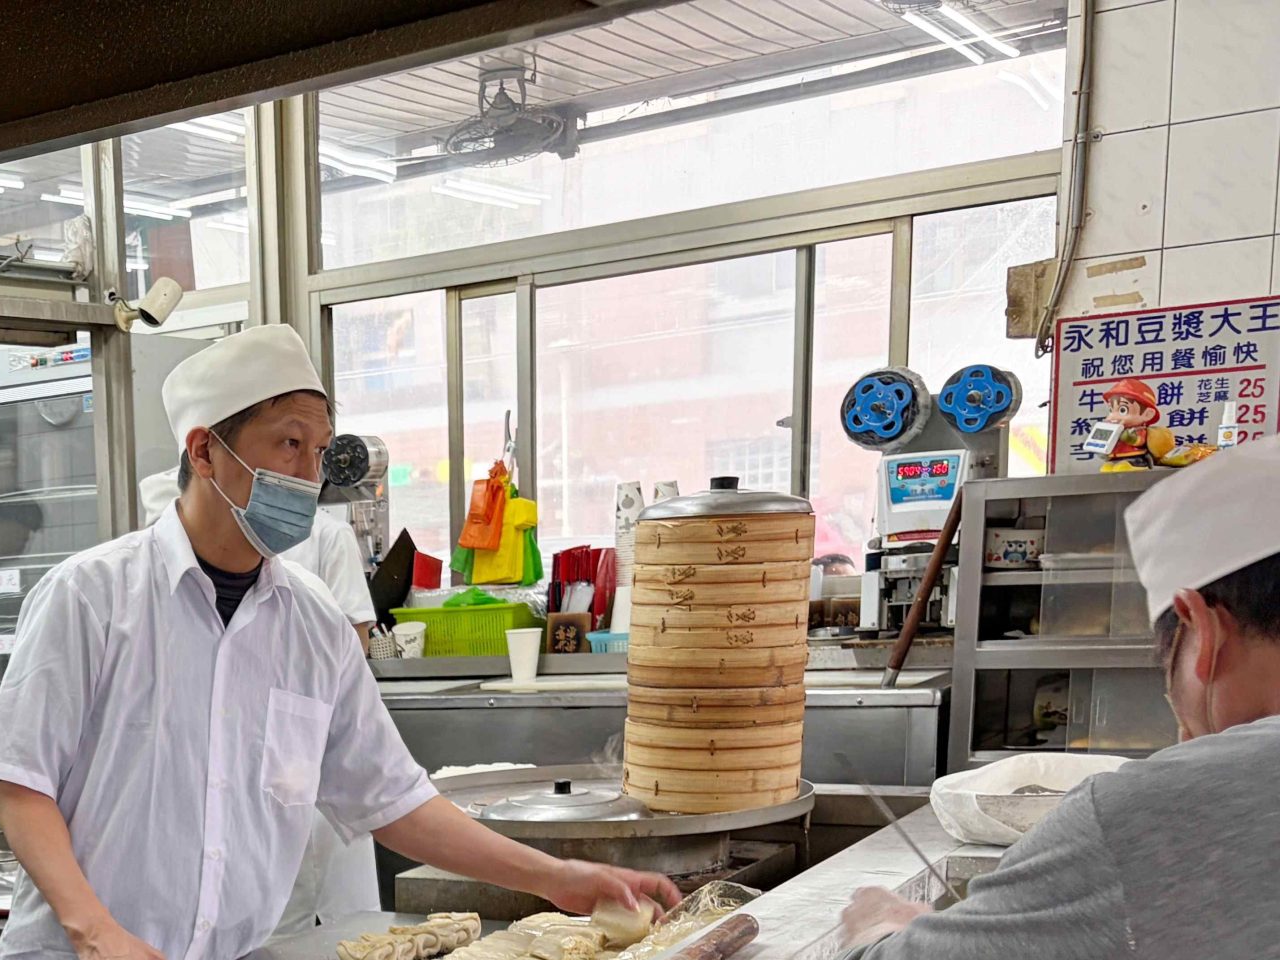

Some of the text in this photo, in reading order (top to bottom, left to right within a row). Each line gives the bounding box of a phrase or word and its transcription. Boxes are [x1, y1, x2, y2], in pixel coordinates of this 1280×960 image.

[1063, 302, 1280, 353] 永和豆漿大王
[1081, 341, 1259, 379] 祝您用餐愉快
[1197, 377, 1230, 390] 花生
[1238, 378, 1266, 399] 25
[1236, 404, 1266, 424] 25
